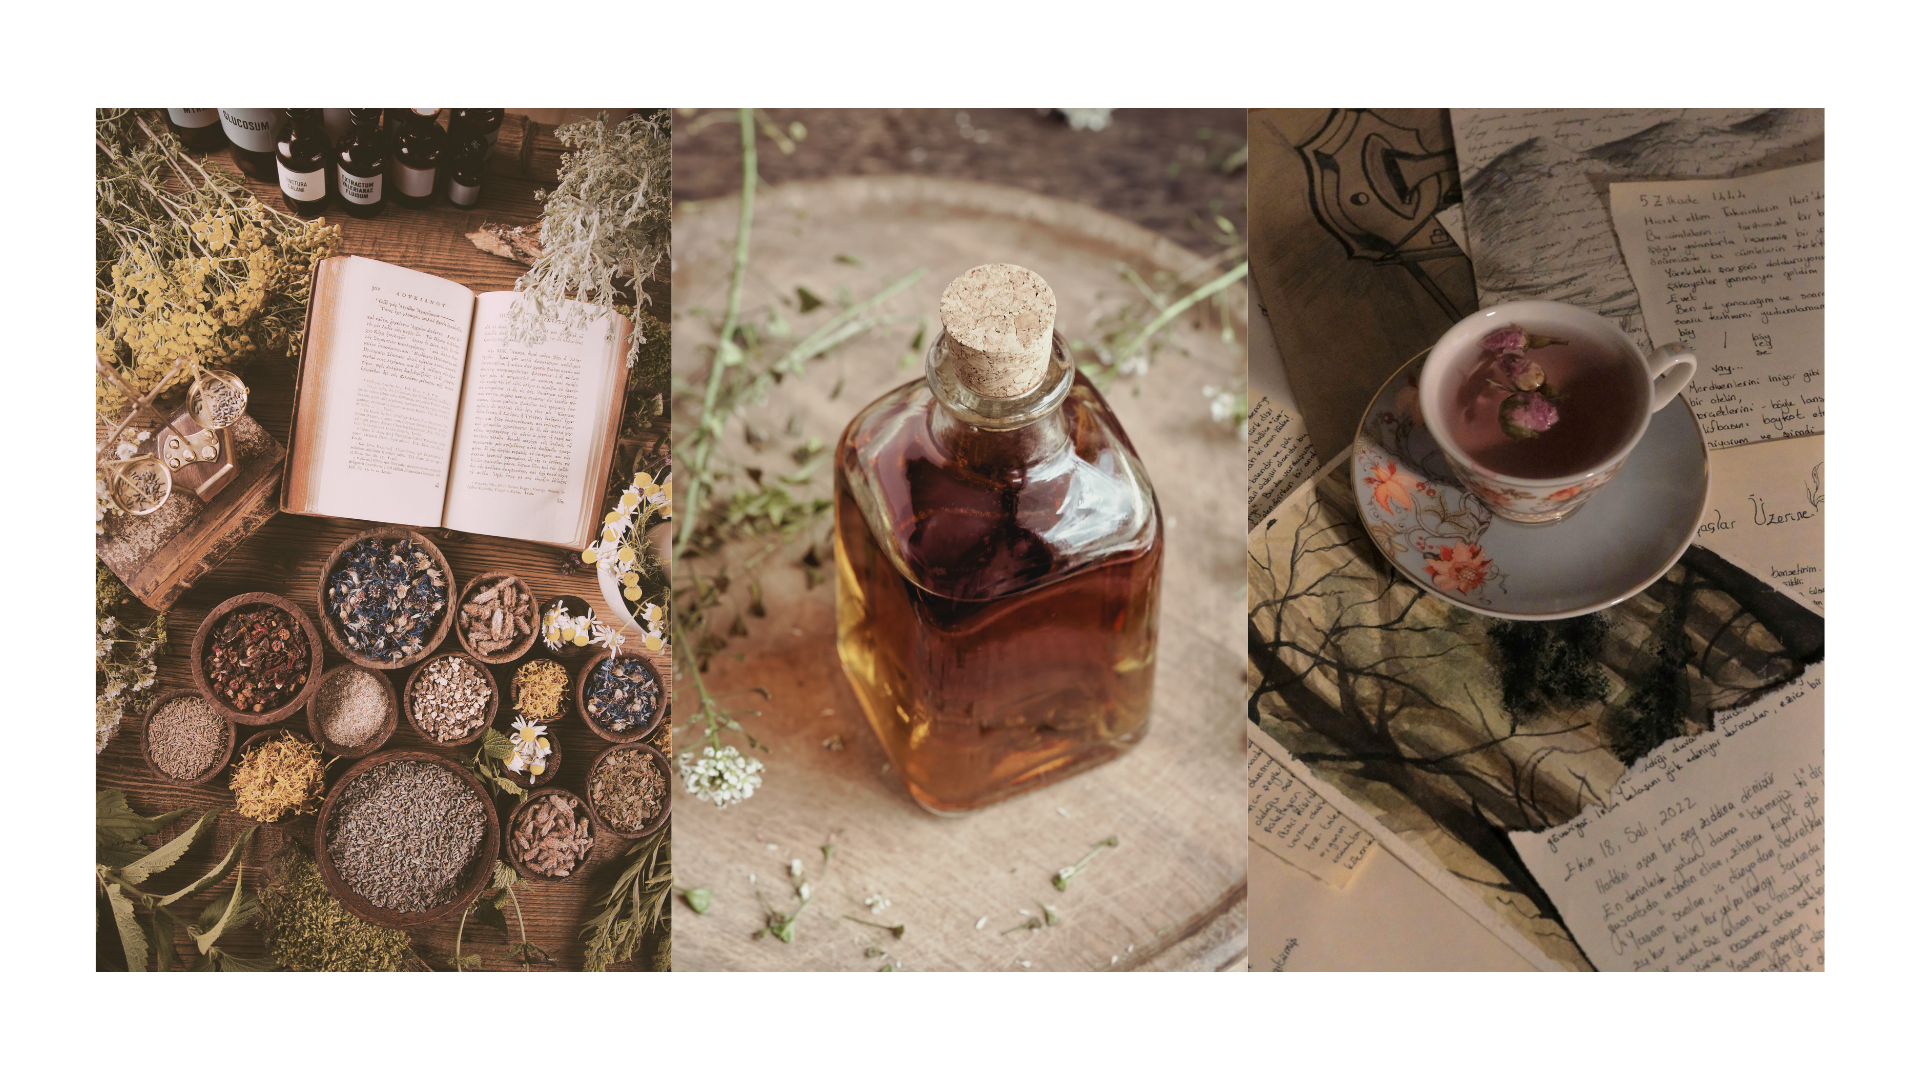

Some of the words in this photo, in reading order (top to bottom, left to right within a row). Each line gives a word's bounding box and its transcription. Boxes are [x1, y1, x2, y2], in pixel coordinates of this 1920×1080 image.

[222, 109, 270, 131] GLUCOSUM
[1639, 194, 1649, 207] 5
[1675, 303, 1697, 315] Ben
[1803, 368, 1821, 384] gibi
[1689, 397, 1704, 408] bir
[1659, 796, 1697, 826] 2022
[1657, 835, 1677, 854] her
